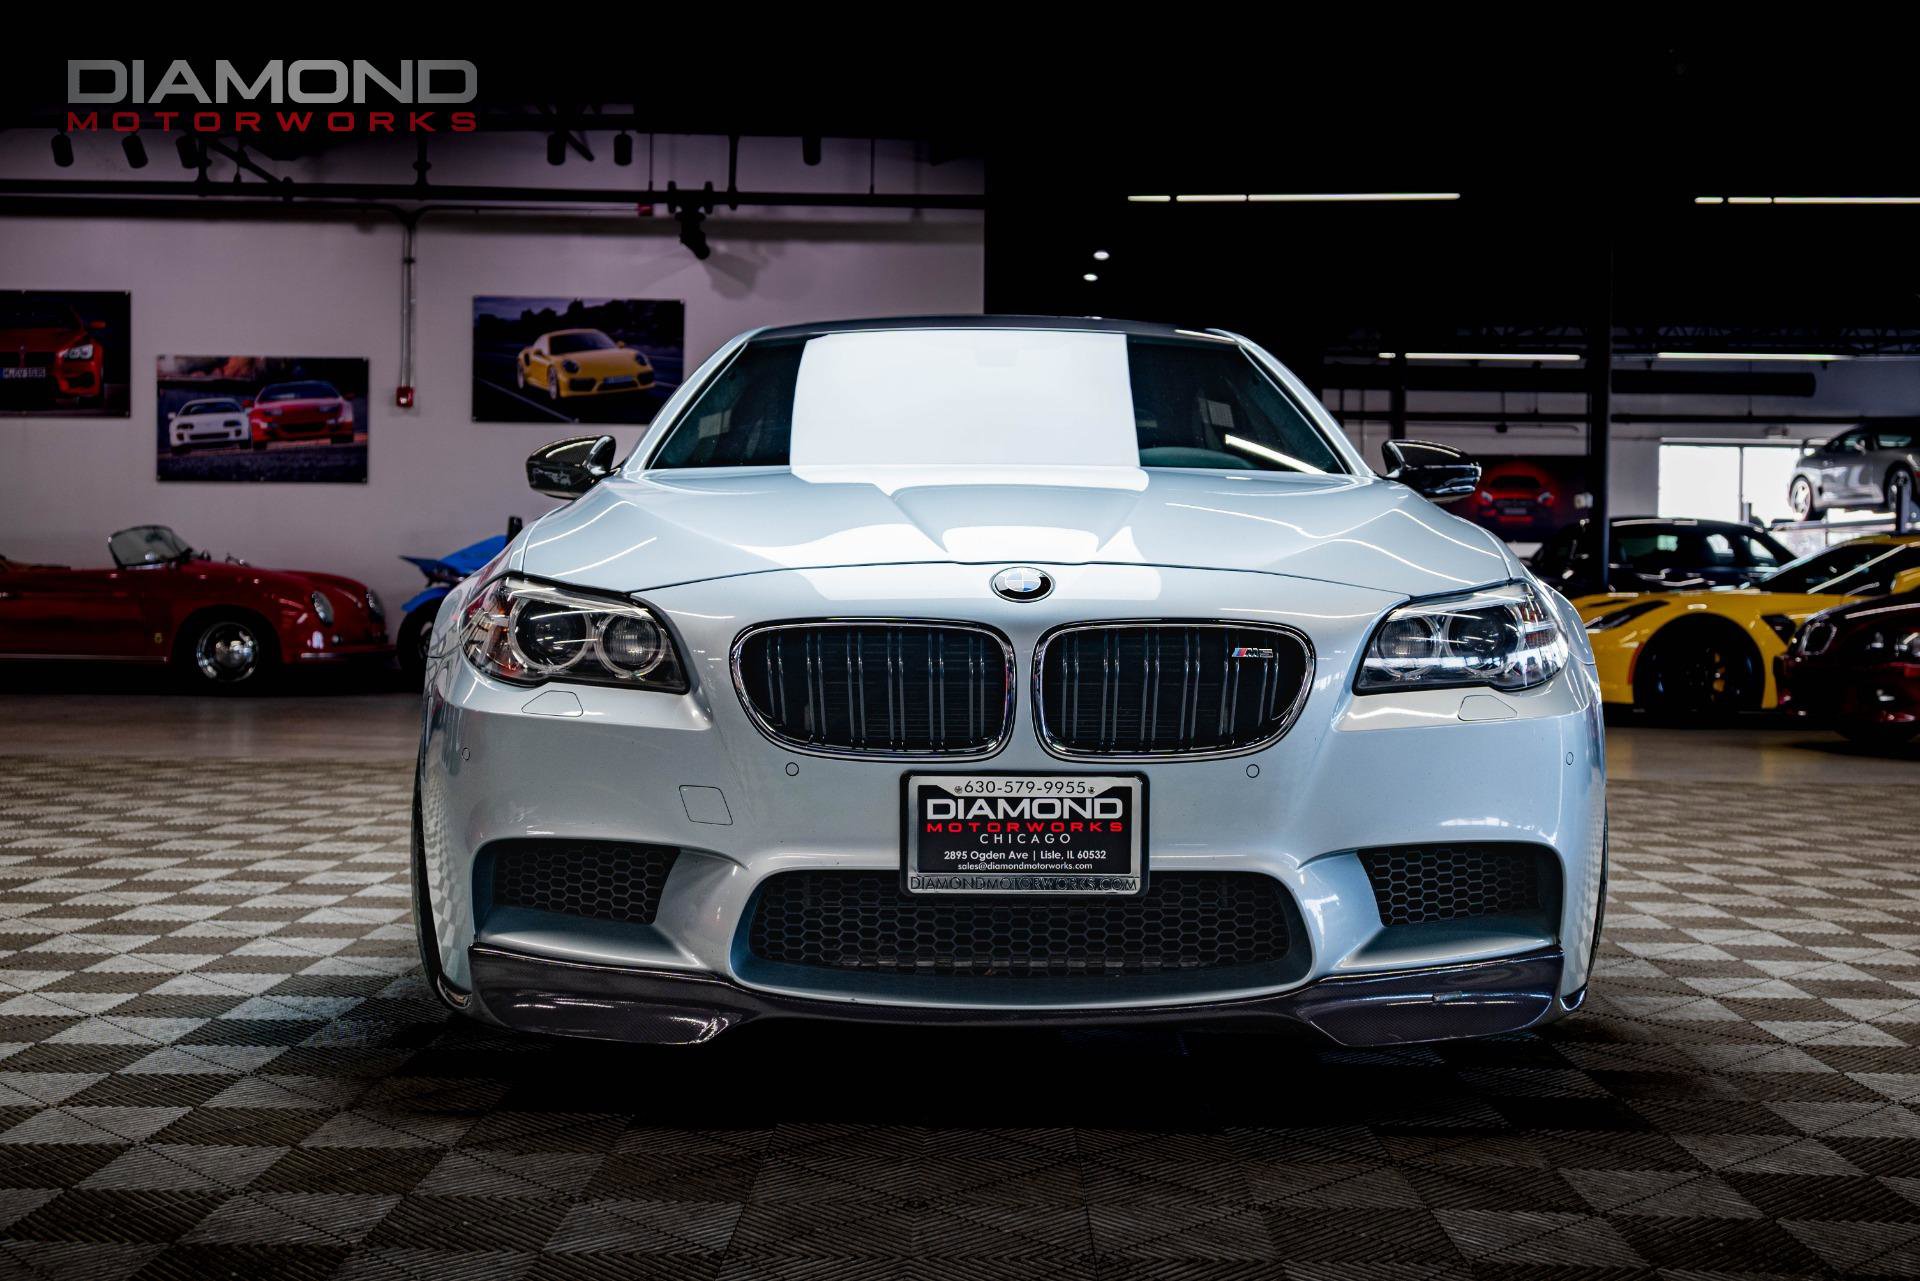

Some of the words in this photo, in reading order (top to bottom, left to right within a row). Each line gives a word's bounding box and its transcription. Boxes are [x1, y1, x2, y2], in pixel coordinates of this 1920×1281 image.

[964, 781, 1086, 794] 630-579-9955
[927, 798, 1123, 819] DIAMOND
[927, 822, 1123, 832] MOTORWORKS
[980, 833, 1071, 844] CHICAGO
[944, 851, 967, 860] 2895
[970, 850, 1005, 861] Ogden
[1008, 851, 1028, 860] Ave
[1040, 850, 1064, 861] Lisle,
[1066, 851, 1075, 860] IL
[1077, 851, 1107, 860] 60532
[958, 862, 1093, 870] sales@diamondmotorworks.com
